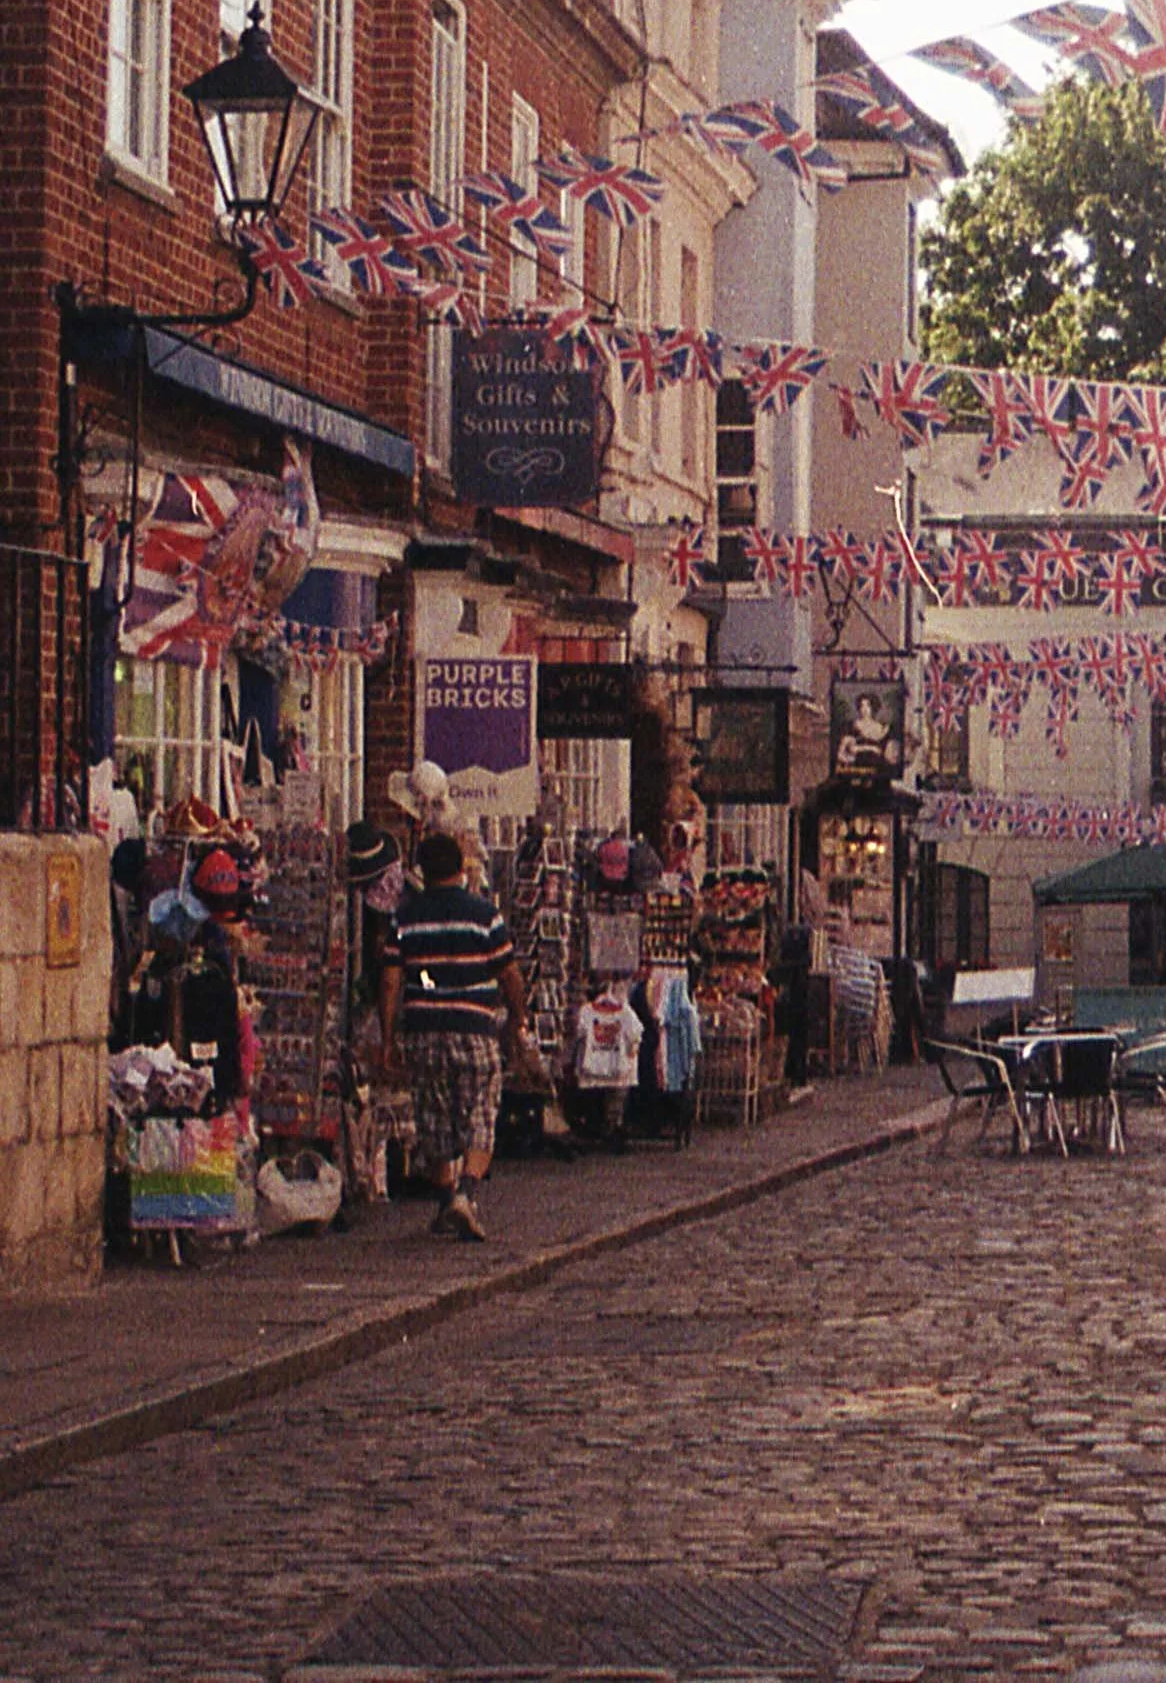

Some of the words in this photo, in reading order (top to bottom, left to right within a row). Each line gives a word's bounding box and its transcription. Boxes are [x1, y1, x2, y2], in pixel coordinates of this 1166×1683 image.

[477, 382, 537, 406] Gifts
[551, 384, 571, 406] &
[462, 413, 592, 436] Souvenirs
[426, 664, 526, 685] PURPLE
[426, 687, 526, 709] BRICKS
